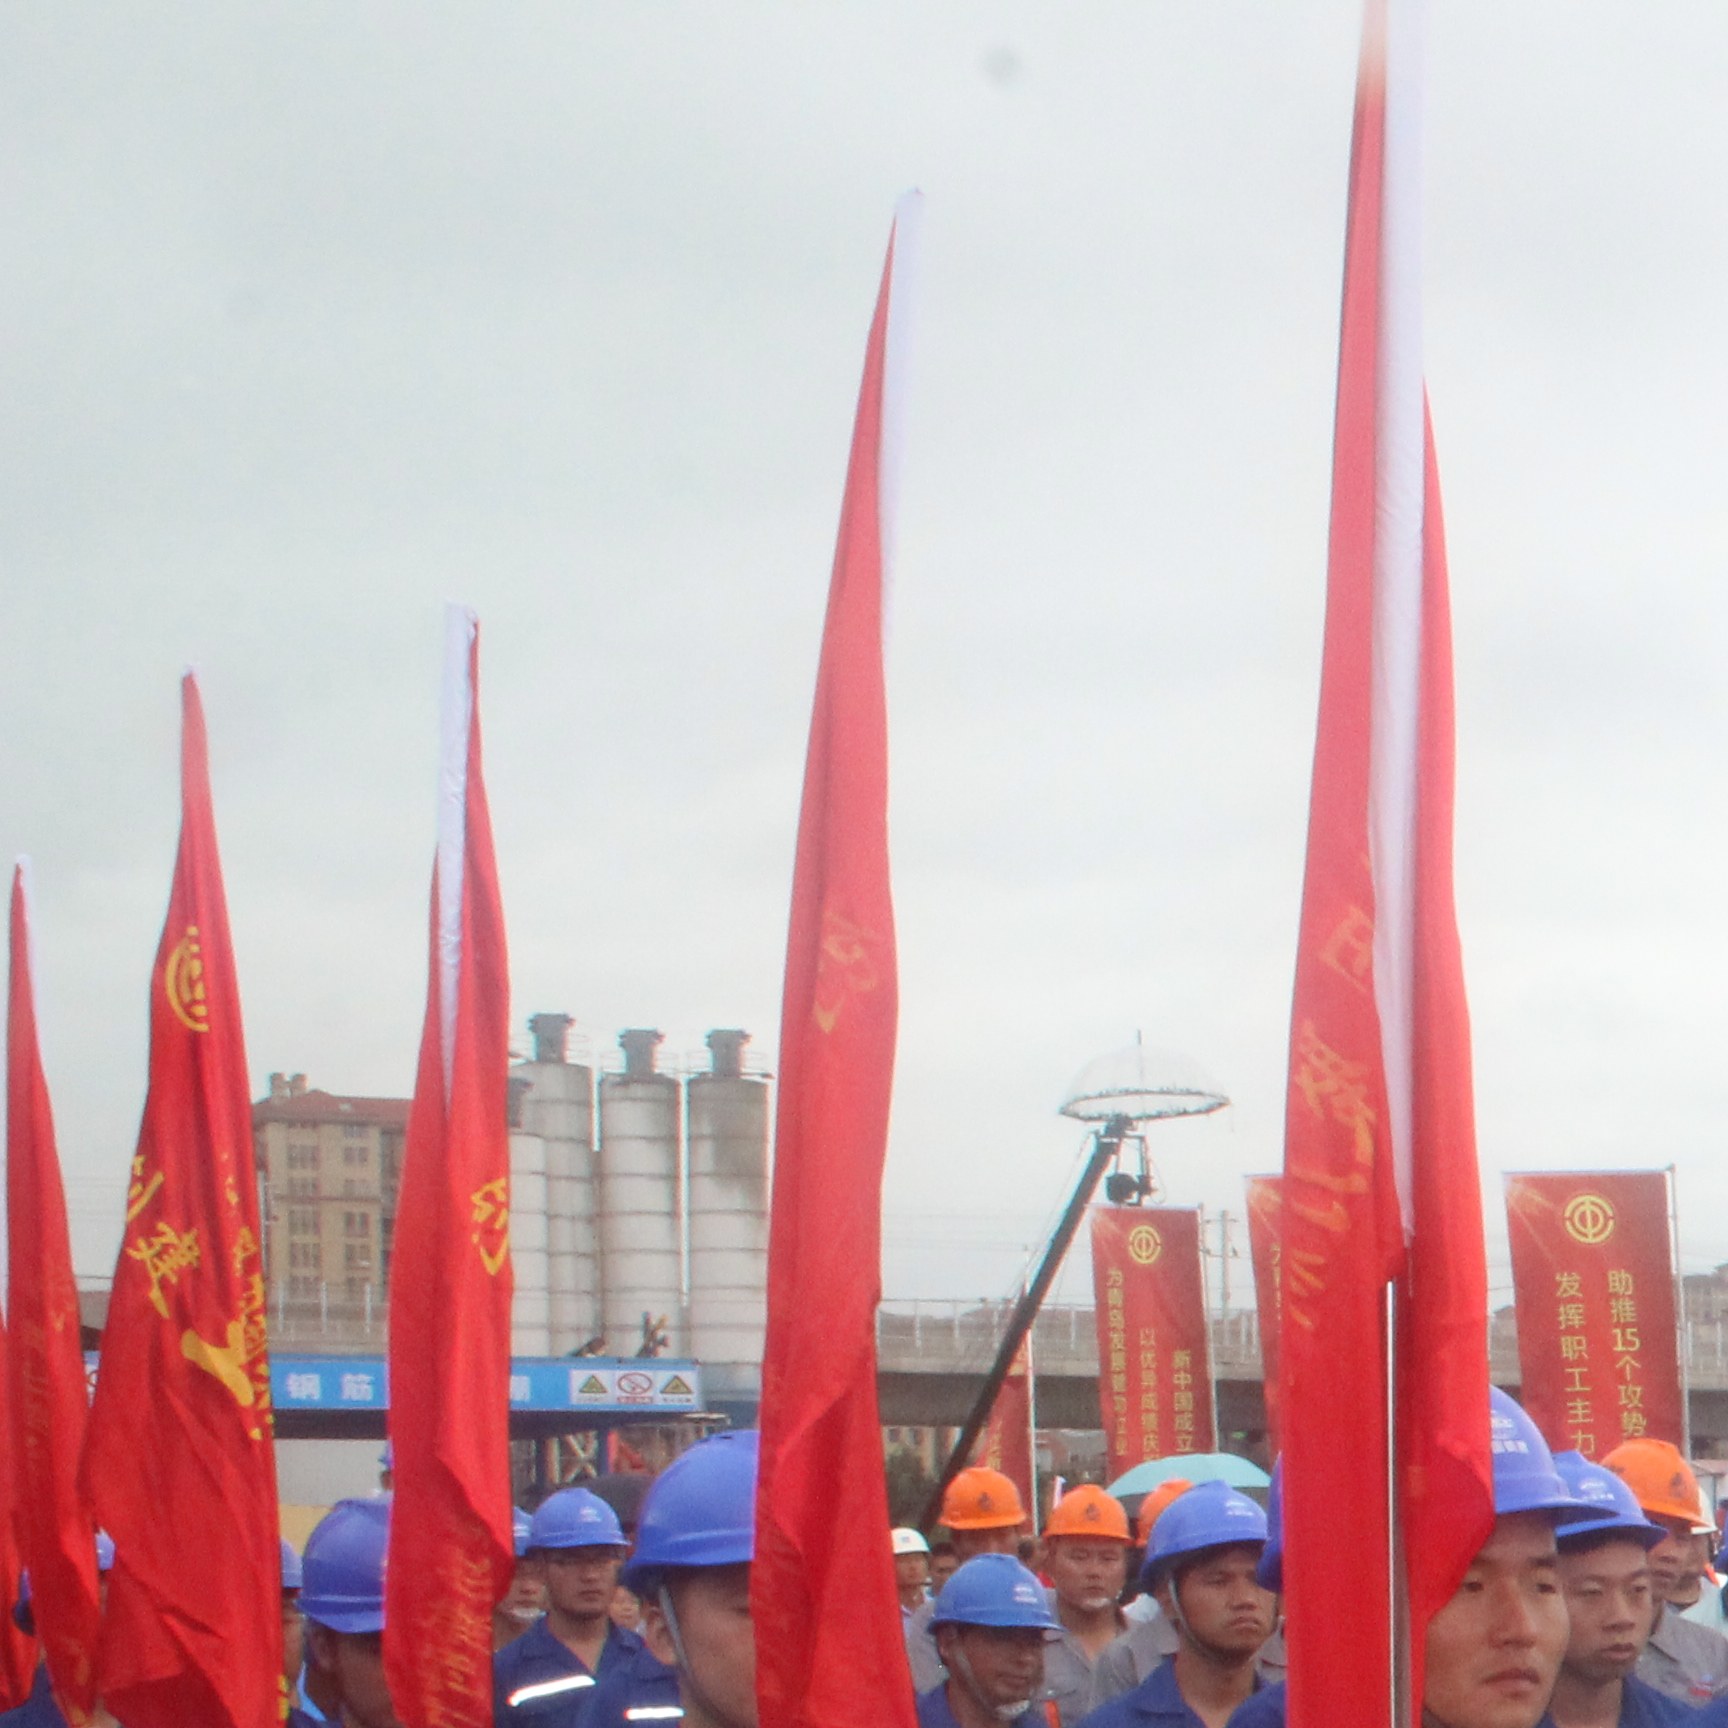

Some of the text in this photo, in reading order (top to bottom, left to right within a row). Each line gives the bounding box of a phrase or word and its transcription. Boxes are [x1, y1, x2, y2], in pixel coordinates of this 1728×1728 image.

[1554, 1272, 1595, 1456] 发挥职工主力
[1607, 1269, 1647, 1438] 助推15个攻势
